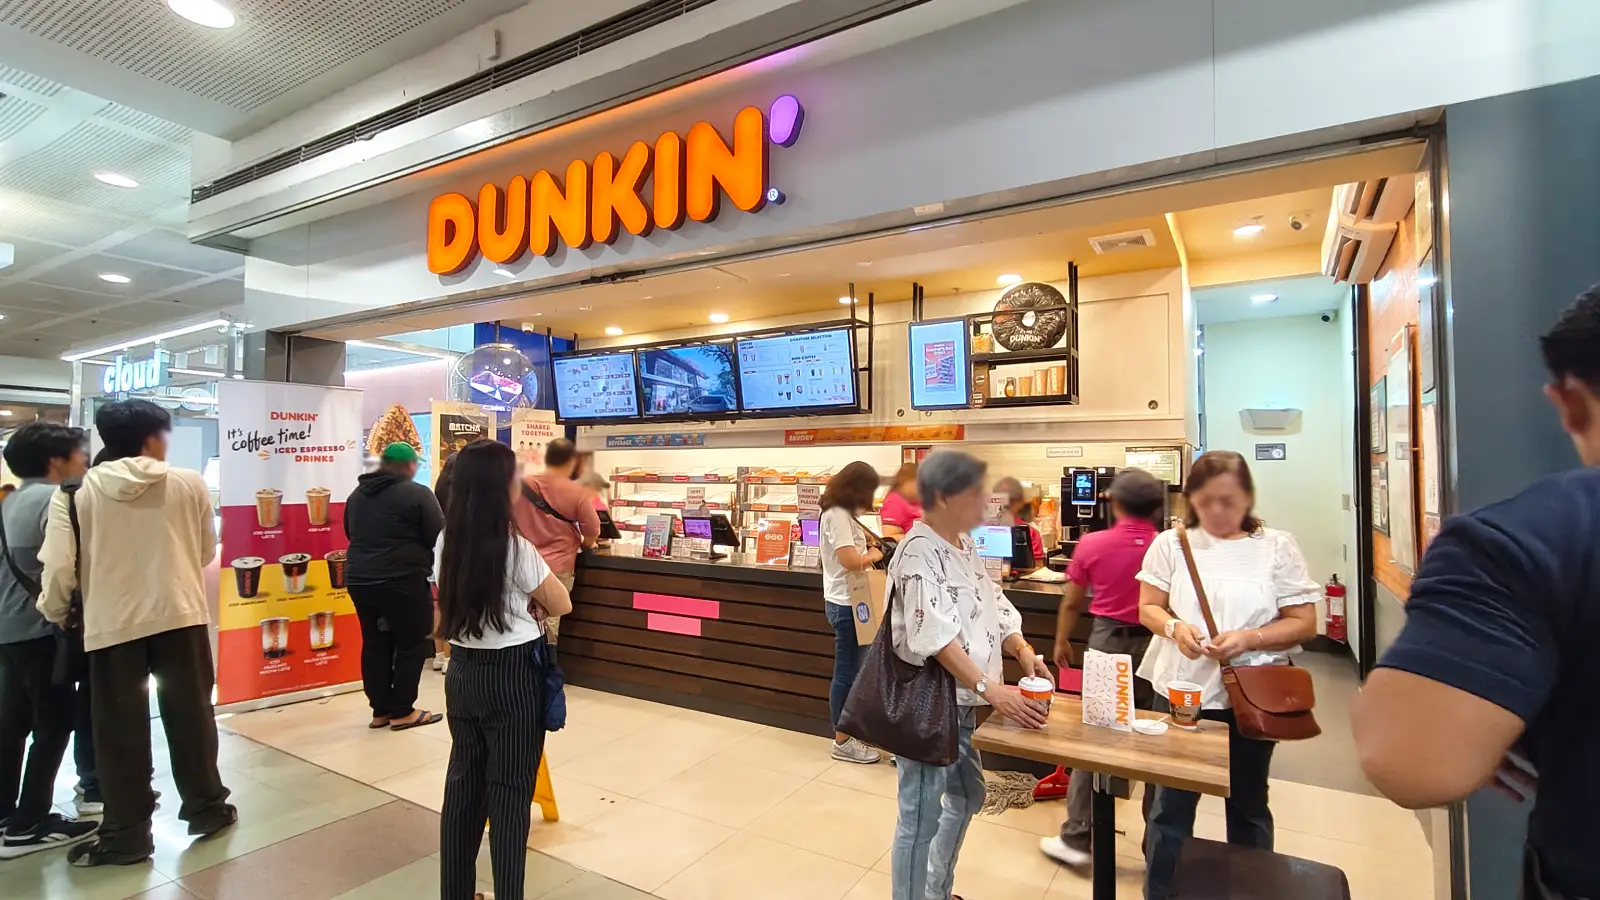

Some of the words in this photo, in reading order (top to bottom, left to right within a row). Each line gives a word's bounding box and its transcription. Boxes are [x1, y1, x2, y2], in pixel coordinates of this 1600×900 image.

[427, 94, 804, 276] DUNKIN'
[104, 348, 162, 394] cloud
[270, 411, 318, 422] DUNKIN'
[526, 423, 551, 431] SHARED
[228, 428, 243, 440] It's
[232, 430, 275, 453] coffee
[277, 423, 312, 444] time!
[300, 445, 345, 453] ESPRESSO
[295, 455, 334, 463] DRINKS
[1116, 661, 1129, 726] DUNKIN'
